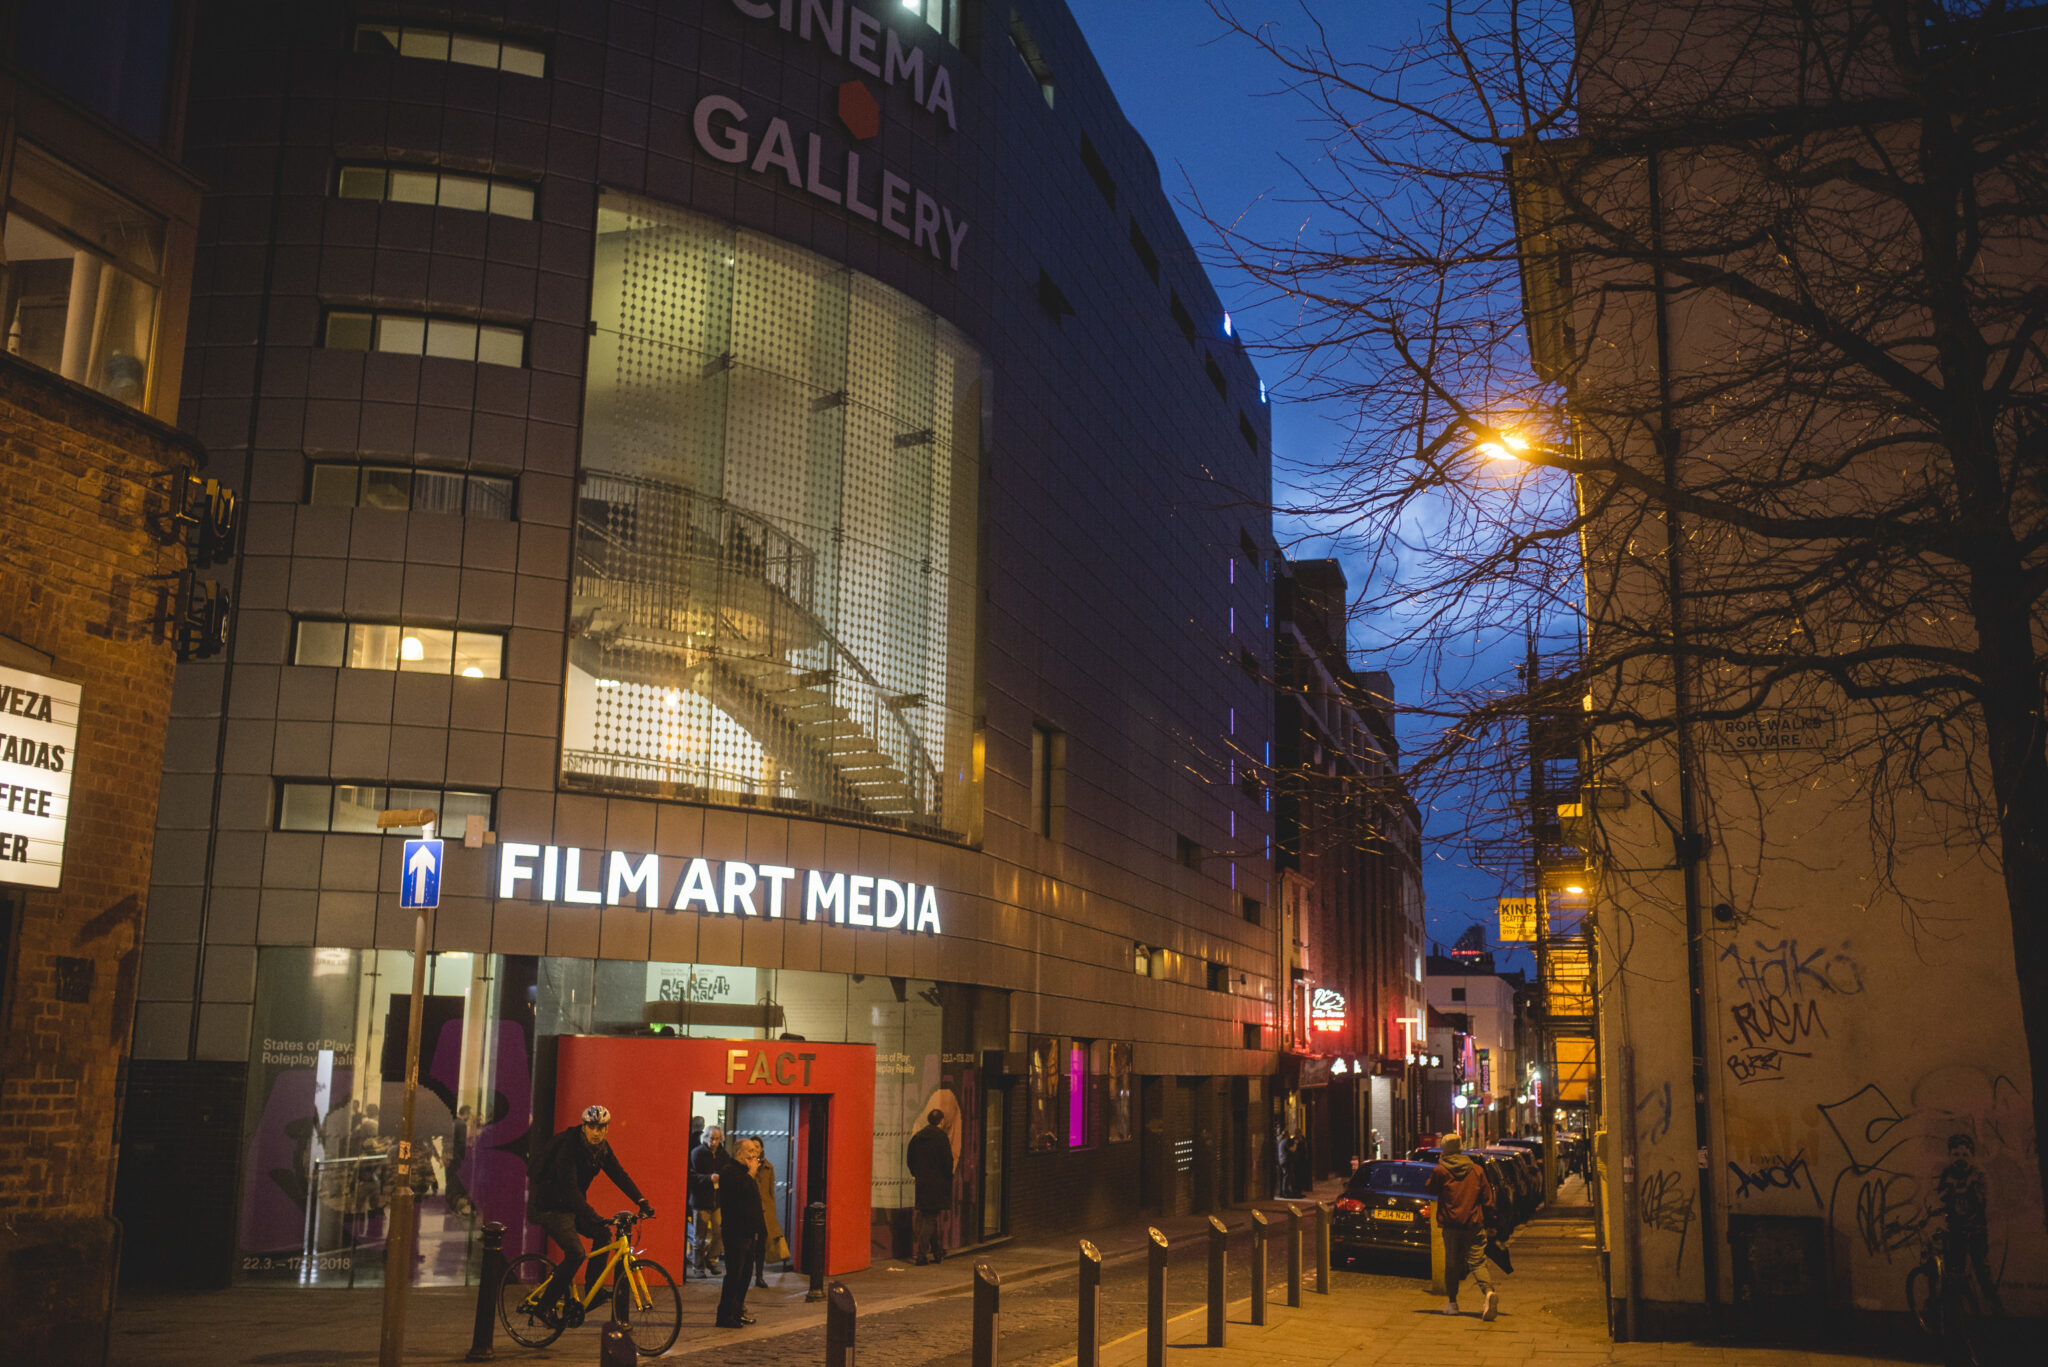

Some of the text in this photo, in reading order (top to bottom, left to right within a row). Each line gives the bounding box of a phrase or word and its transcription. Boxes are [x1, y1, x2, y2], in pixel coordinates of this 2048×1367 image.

[731, 0, 958, 131] INEMA
[693, 94, 969, 271] GALLERY
[1736, 734, 1801, 747] SQUARE
[0, 832, 28, 863] ER
[499, 842, 941, 934] FILM ART MEDIA
[261, 1052, 318, 1068] Roleplay
[263, 1038, 303, 1051] States
[306, 1039, 320, 1051] of
[726, 1049, 817, 1087] FACT
